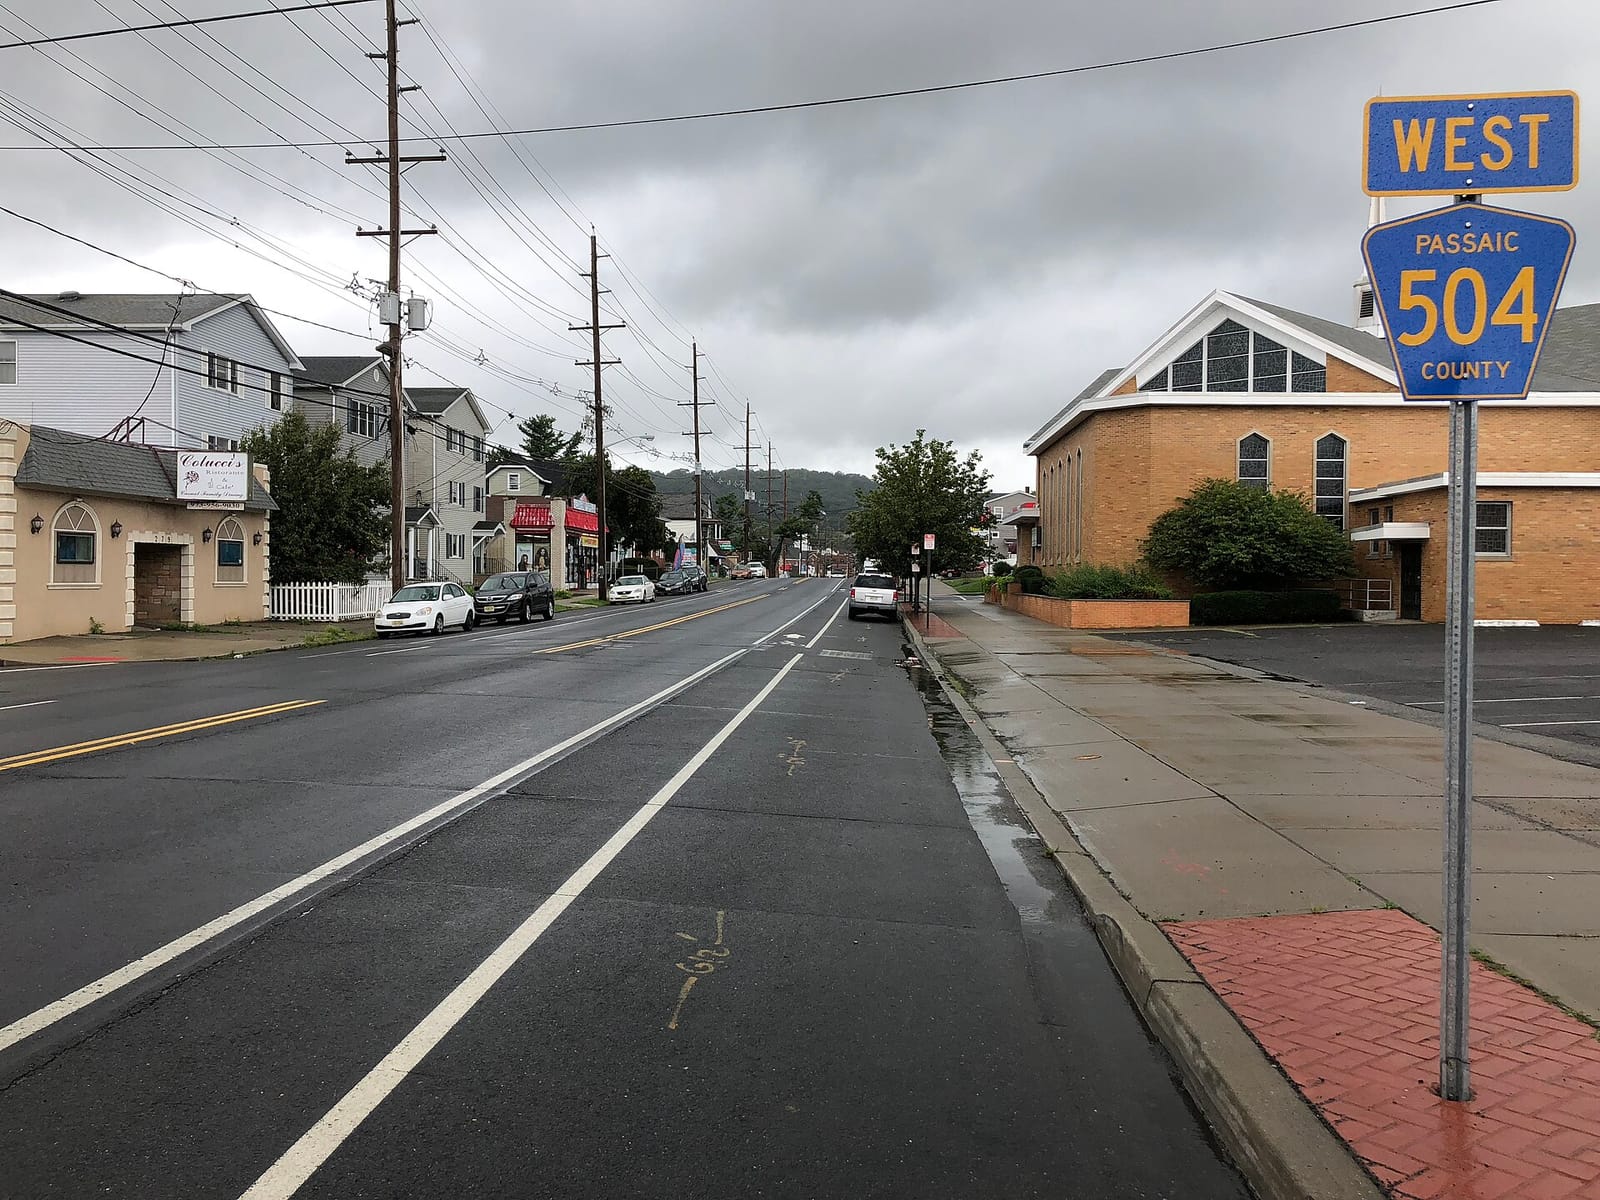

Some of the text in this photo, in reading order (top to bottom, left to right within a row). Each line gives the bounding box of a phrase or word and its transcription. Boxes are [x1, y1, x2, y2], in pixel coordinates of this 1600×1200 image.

[1392, 112, 1550, 174] WEST
[1415, 230, 1520, 254] PASSAIC
[1396, 265, 1539, 347] 504
[1421, 359, 1512, 380] COUNTY
[180, 453, 242, 468] Colucci's
